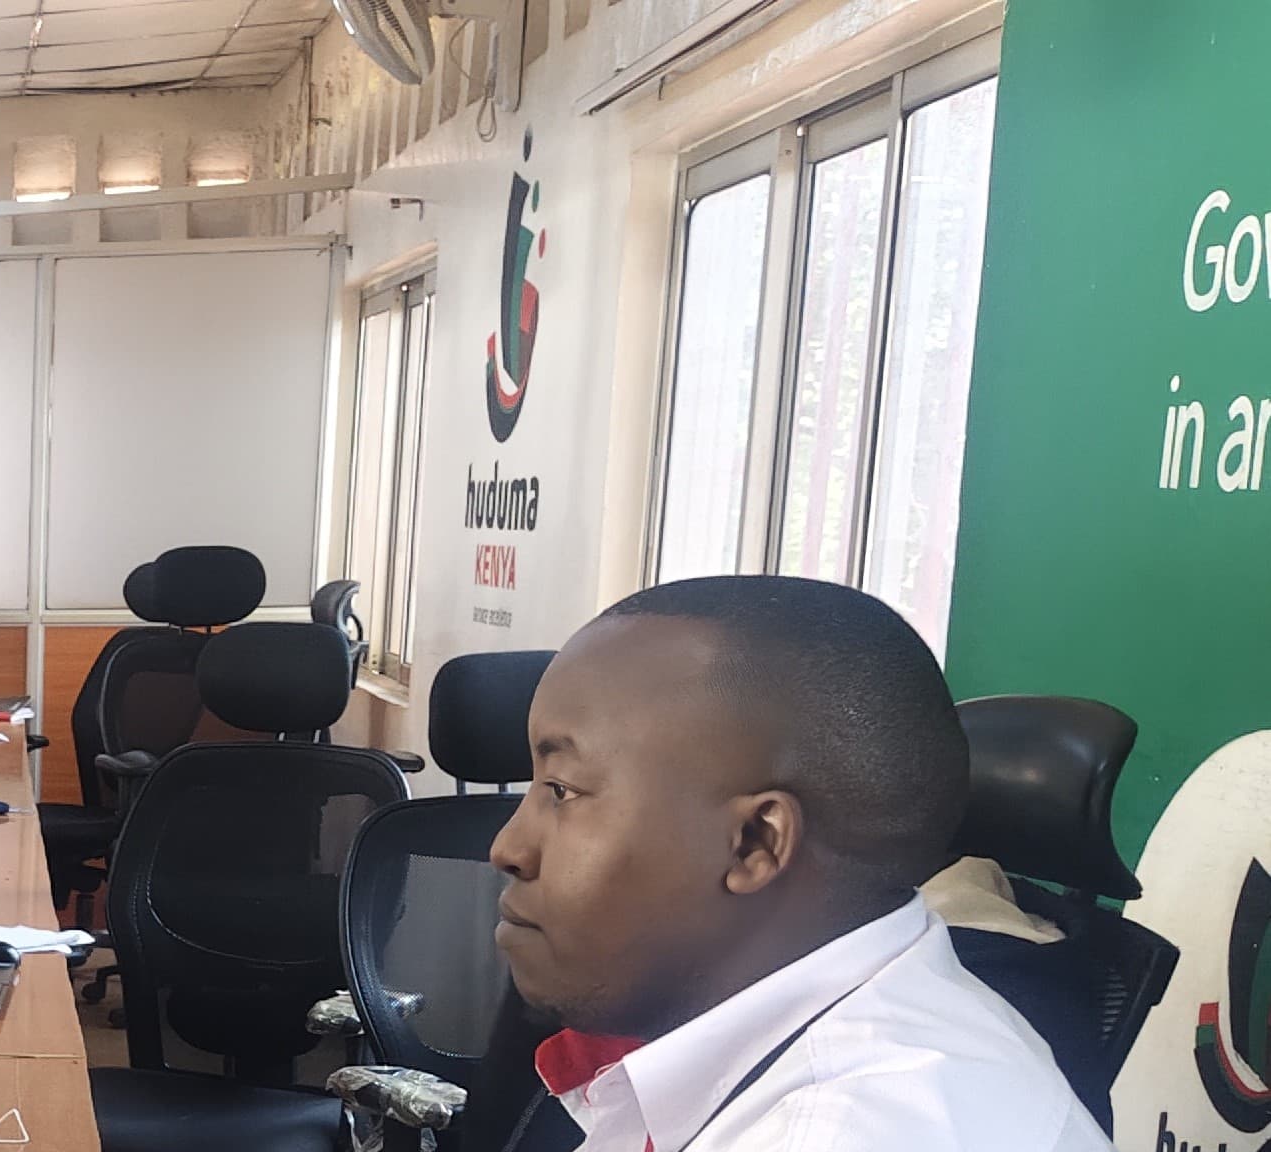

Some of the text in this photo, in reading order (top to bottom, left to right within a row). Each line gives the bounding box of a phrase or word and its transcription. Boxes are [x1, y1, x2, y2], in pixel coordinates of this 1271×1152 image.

[1159, 375, 1205, 489] in
[465, 459, 540, 532] huduma
[474, 543, 516, 591] KENYA
